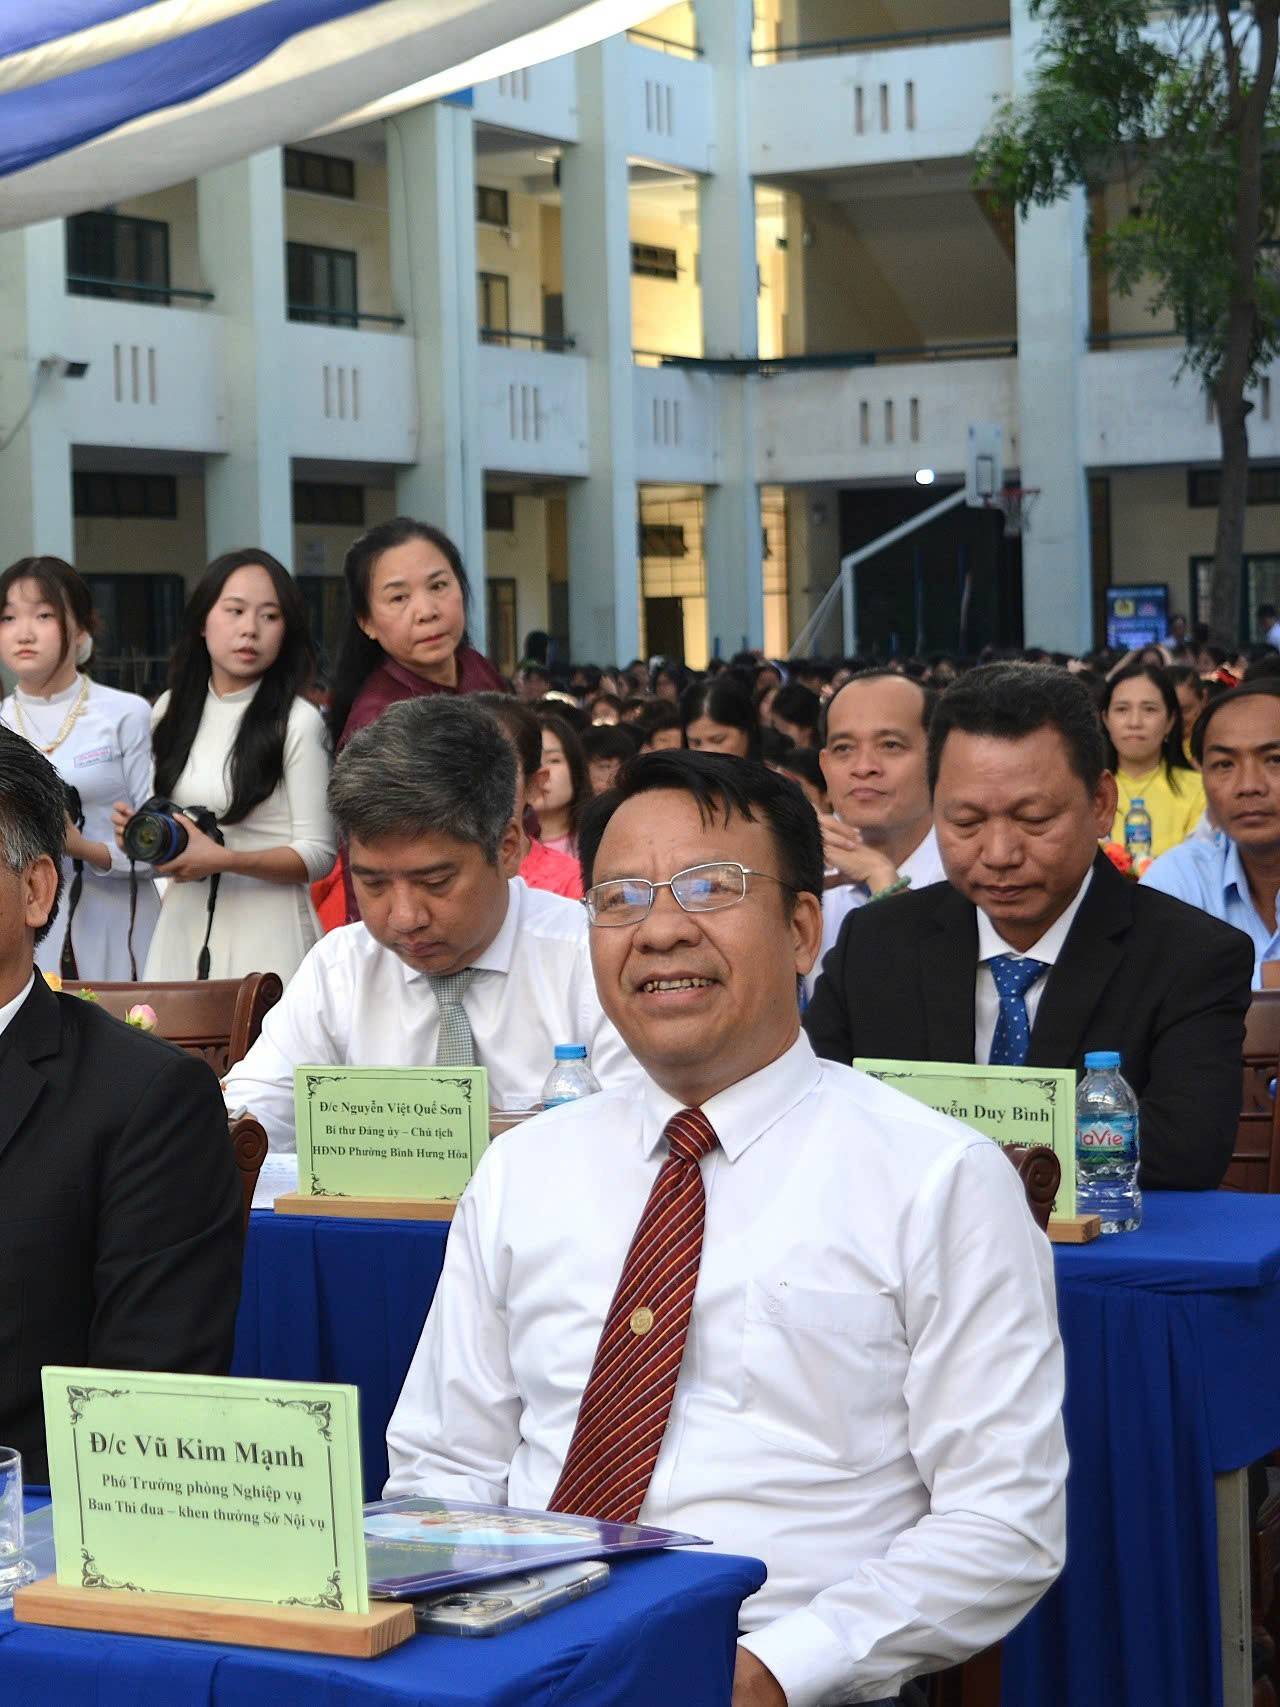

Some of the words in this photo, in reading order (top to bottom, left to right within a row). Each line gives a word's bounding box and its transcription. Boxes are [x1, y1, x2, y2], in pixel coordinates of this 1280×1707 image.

[930, 1100, 968, 1117] yễn
[89, 1432, 126, 1456] Đ/c
[133, 1435, 168, 1458] Vũ
[176, 1437, 226, 1462] Kim
[235, 1441, 305, 1471] Mạnh
[102, 1474, 126, 1488] Phó
[130, 1476, 183, 1496] Trưởng
[186, 1481, 229, 1499] phòng
[232, 1484, 282, 1503] Nghiệp
[285, 1489, 302, 1504] vụ
[88, 1498, 111, 1513] Ban
[115, 1500, 136, 1514] Thi
[140, 1502, 164, 1516] đua
[178, 1506, 209, 1520] khen
[213, 1508, 260, 1526] thưởng
[263, 1512, 279, 1525] Sở
[283, 1514, 305, 1530] Nội
[309, 1518, 325, 1532] vụ
